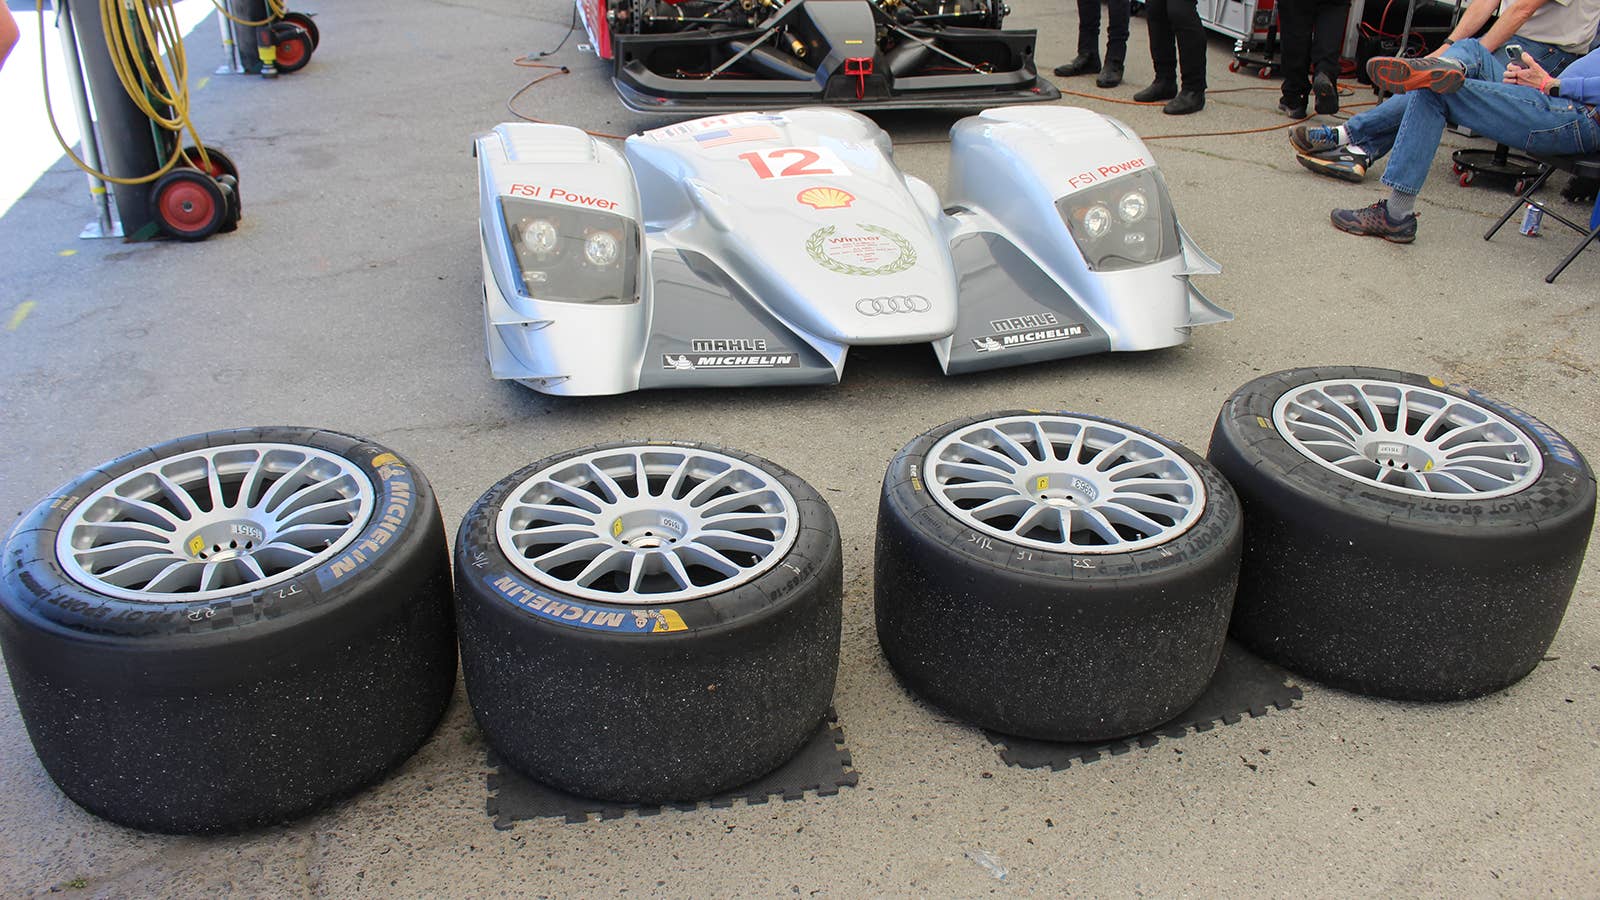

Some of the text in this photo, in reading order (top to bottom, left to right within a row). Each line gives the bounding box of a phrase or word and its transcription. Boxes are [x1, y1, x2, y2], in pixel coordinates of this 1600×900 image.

[738, 148, 835, 179] 12
[1068, 157, 1145, 189] FSI Power
[510, 183, 619, 211] FSI Power
[828, 235, 881, 245] Winner
[990, 312, 1057, 333] MAHLE
[692, 338, 767, 352] MAHLE
[1003, 325, 1082, 346] MICHELIN
[696, 353, 793, 367] MICHELIN
[1420, 503, 1483, 517] SPORT
[330, 480, 411, 579] MICHELIN
[48, 591, 173, 625] PILOT SPORT
[492, 575, 626, 628] MICHELIN
